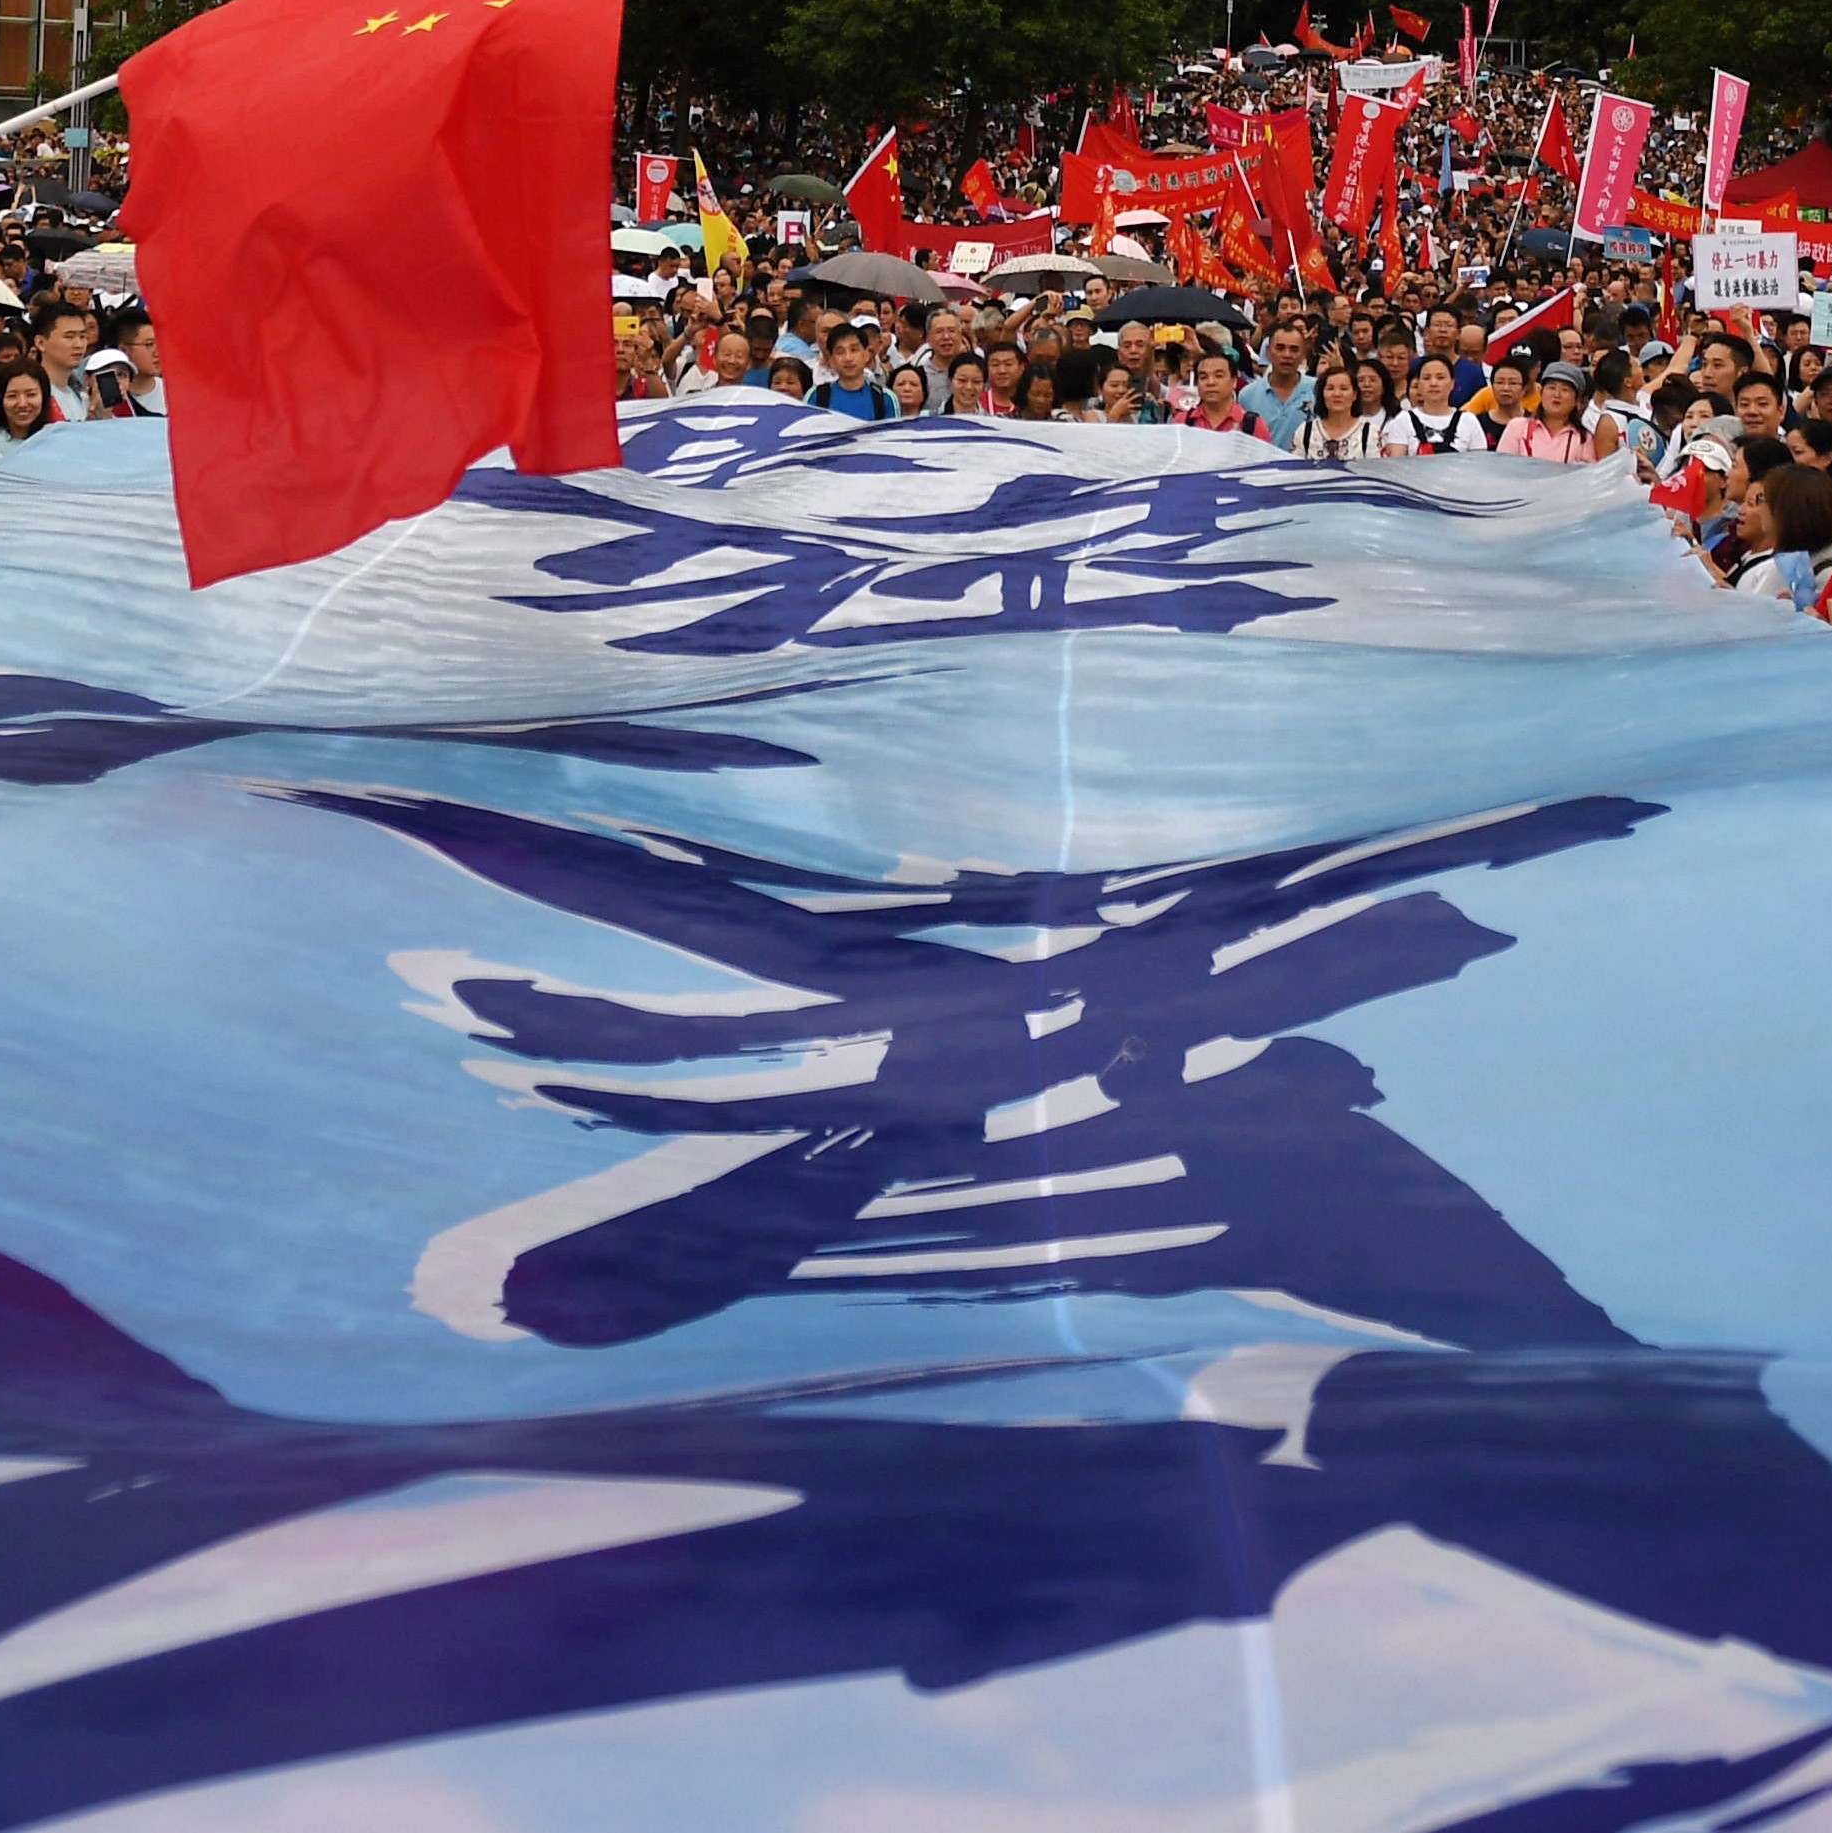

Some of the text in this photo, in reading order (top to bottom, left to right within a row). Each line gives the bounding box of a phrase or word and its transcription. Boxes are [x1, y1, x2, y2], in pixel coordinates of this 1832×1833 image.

[1711, 249, 1779, 272] 停止一切暴力
